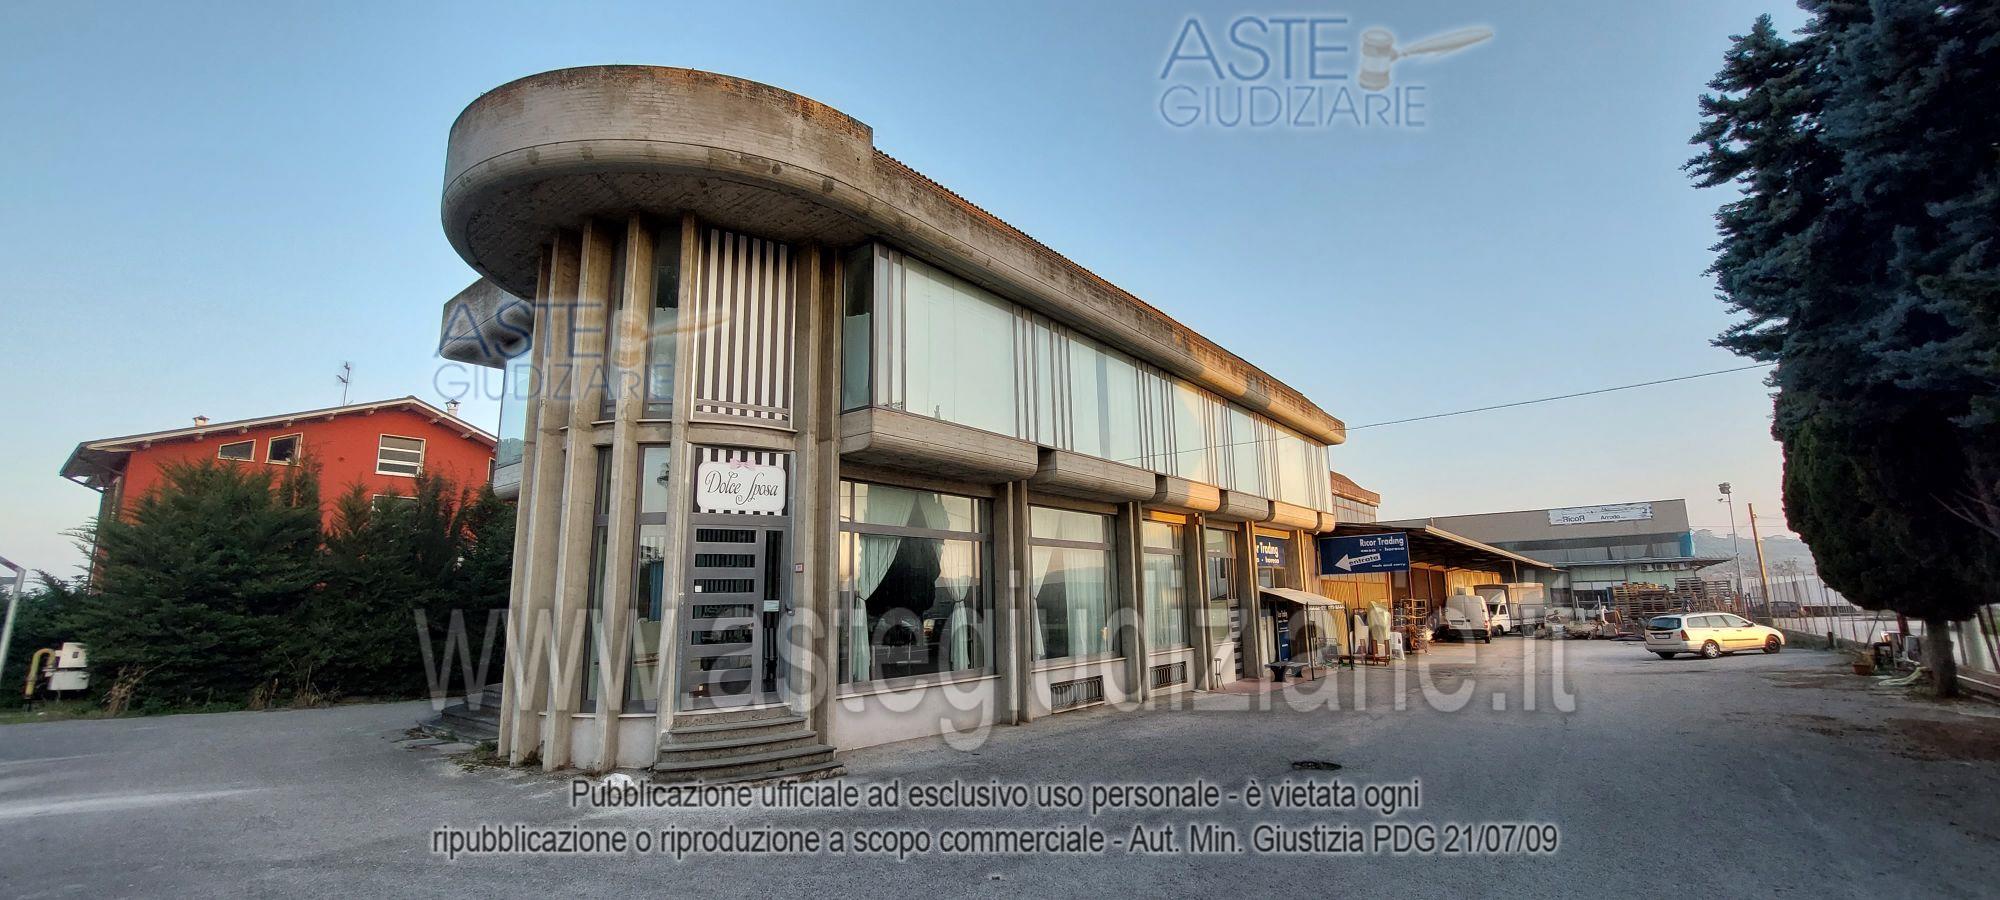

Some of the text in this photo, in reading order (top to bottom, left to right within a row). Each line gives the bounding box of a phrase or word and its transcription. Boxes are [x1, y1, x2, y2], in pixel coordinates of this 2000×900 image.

[704, 470, 779, 506] Dolce Sposa
[1359, 536, 1404, 547] Ricor Trading
